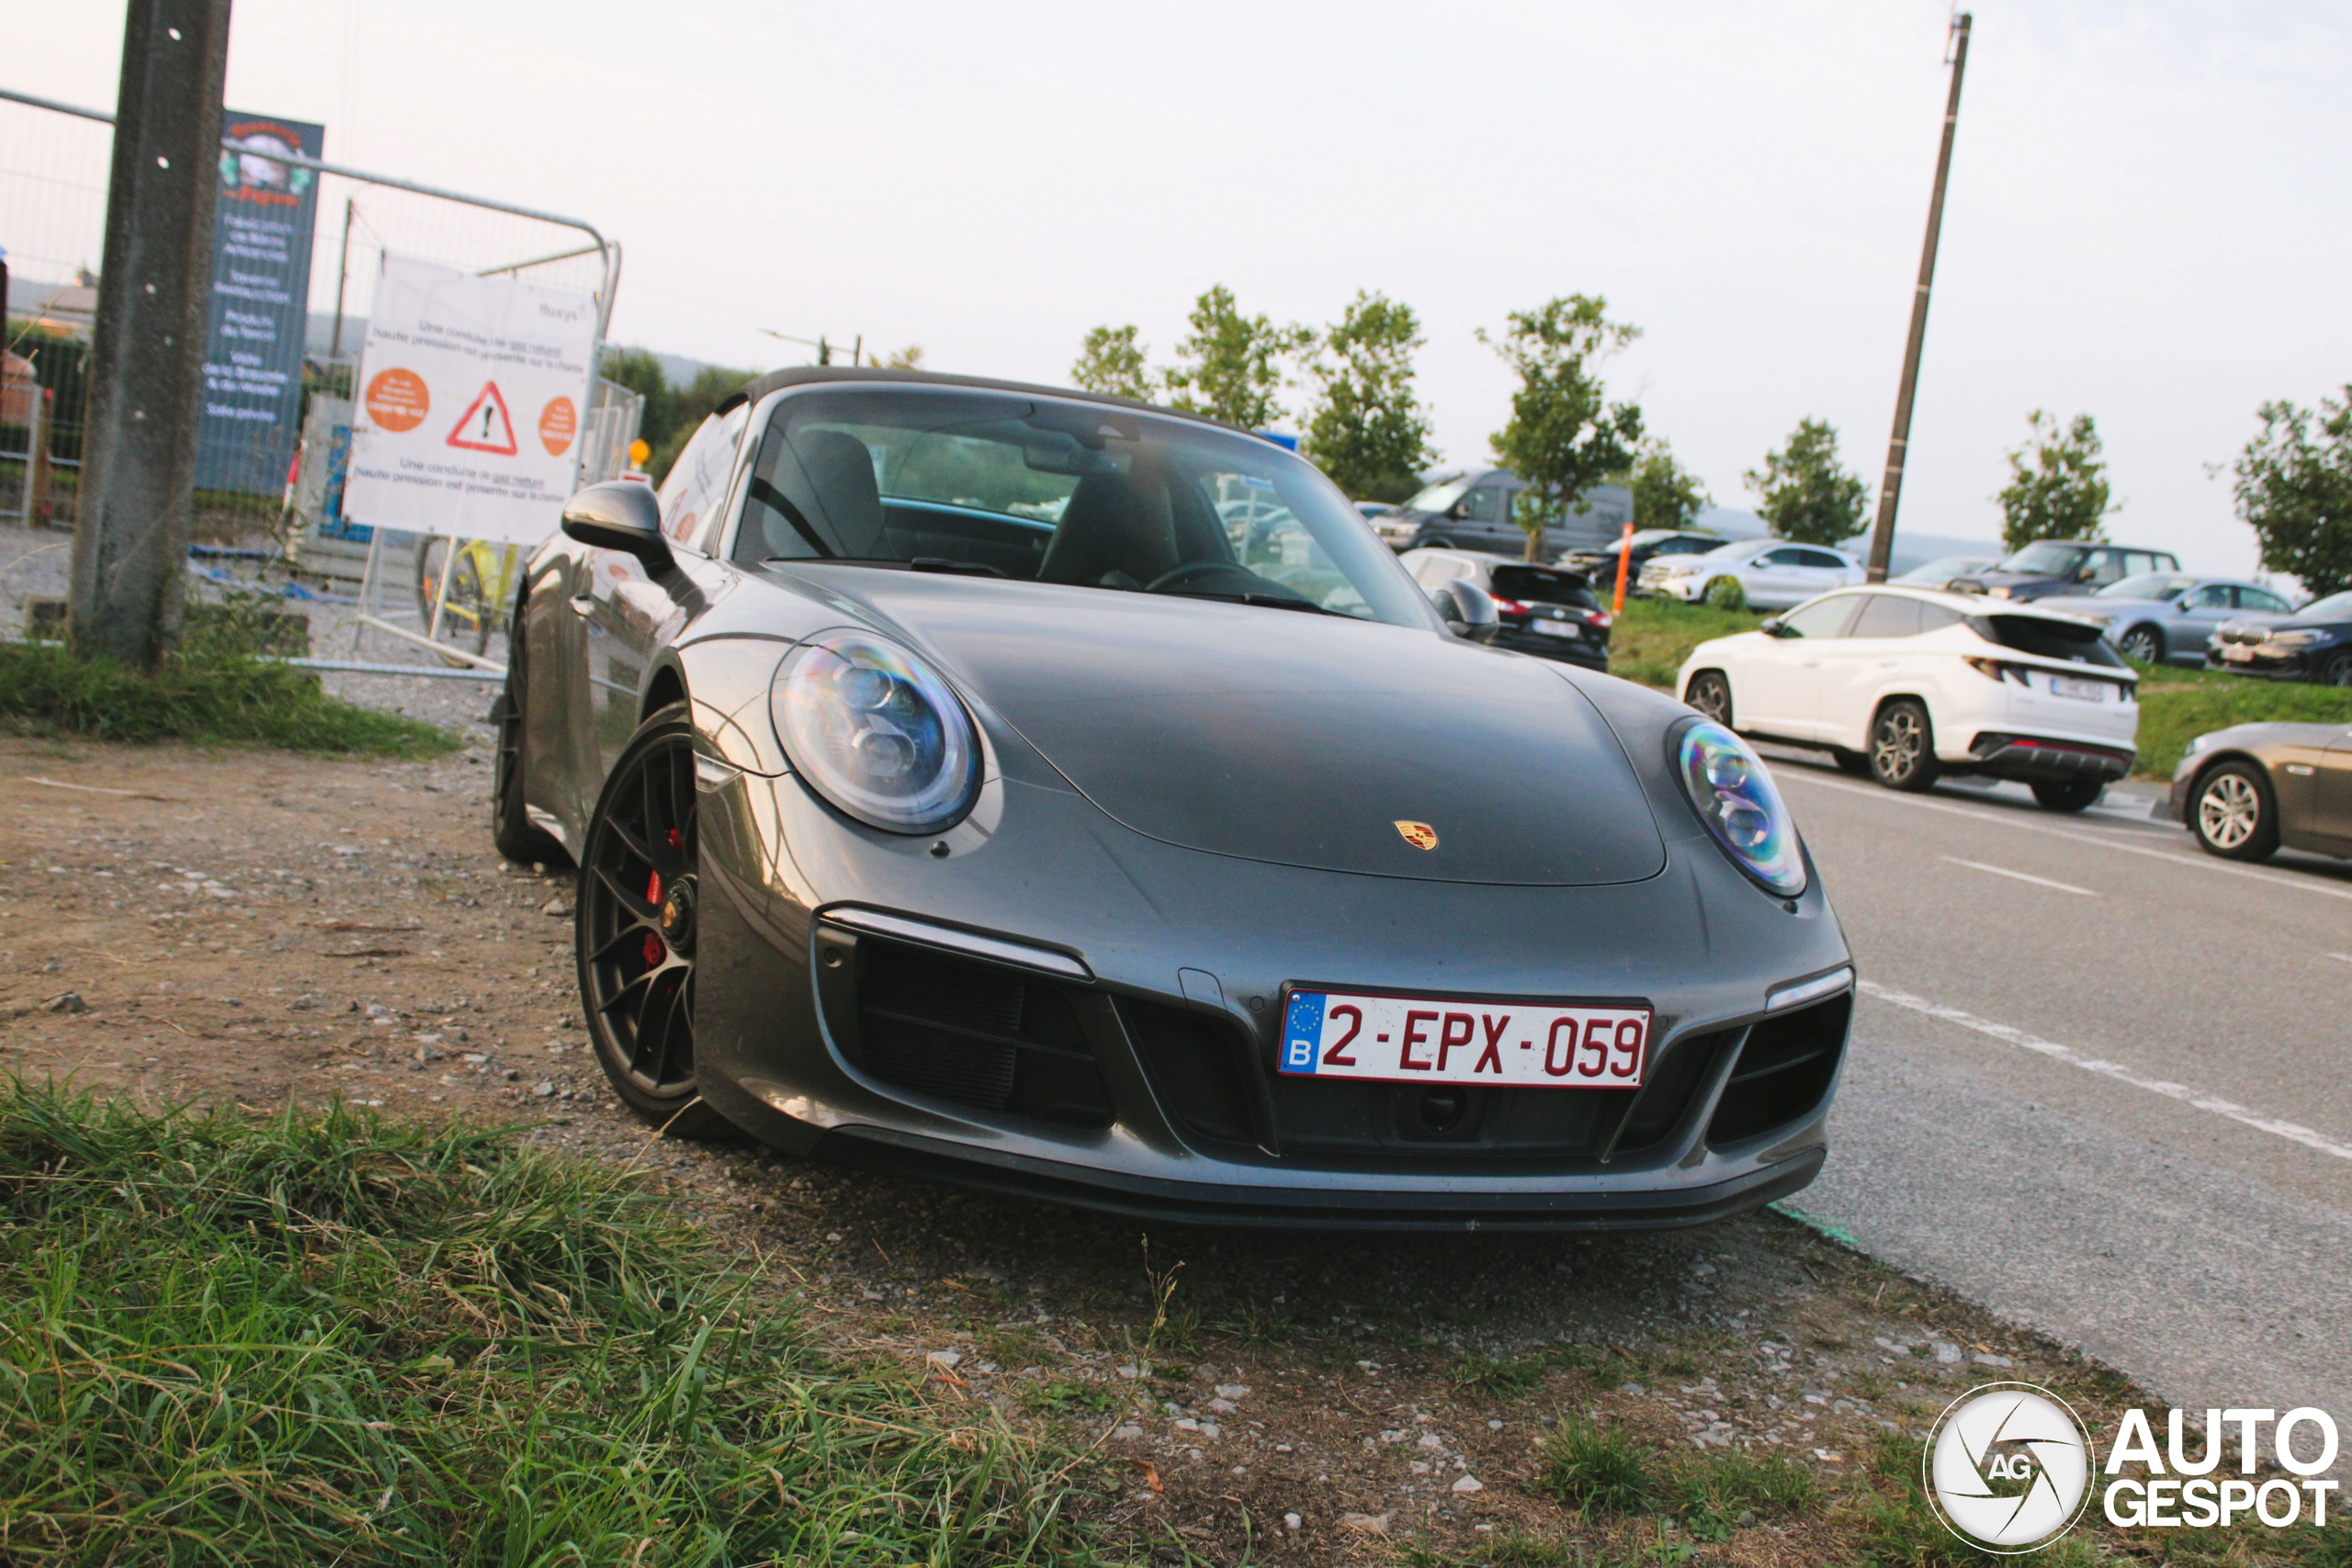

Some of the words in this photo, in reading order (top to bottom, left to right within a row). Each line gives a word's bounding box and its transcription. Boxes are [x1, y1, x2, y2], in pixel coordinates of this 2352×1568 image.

[418, 320, 443, 334] Une
[373, 327, 408, 343] haute
[400, 457, 424, 471] Une
[353, 466, 390, 480] haute
[1289, 1040, 1311, 1066] B
[1323, 1004, 1643, 1077] 2-EPX-059
